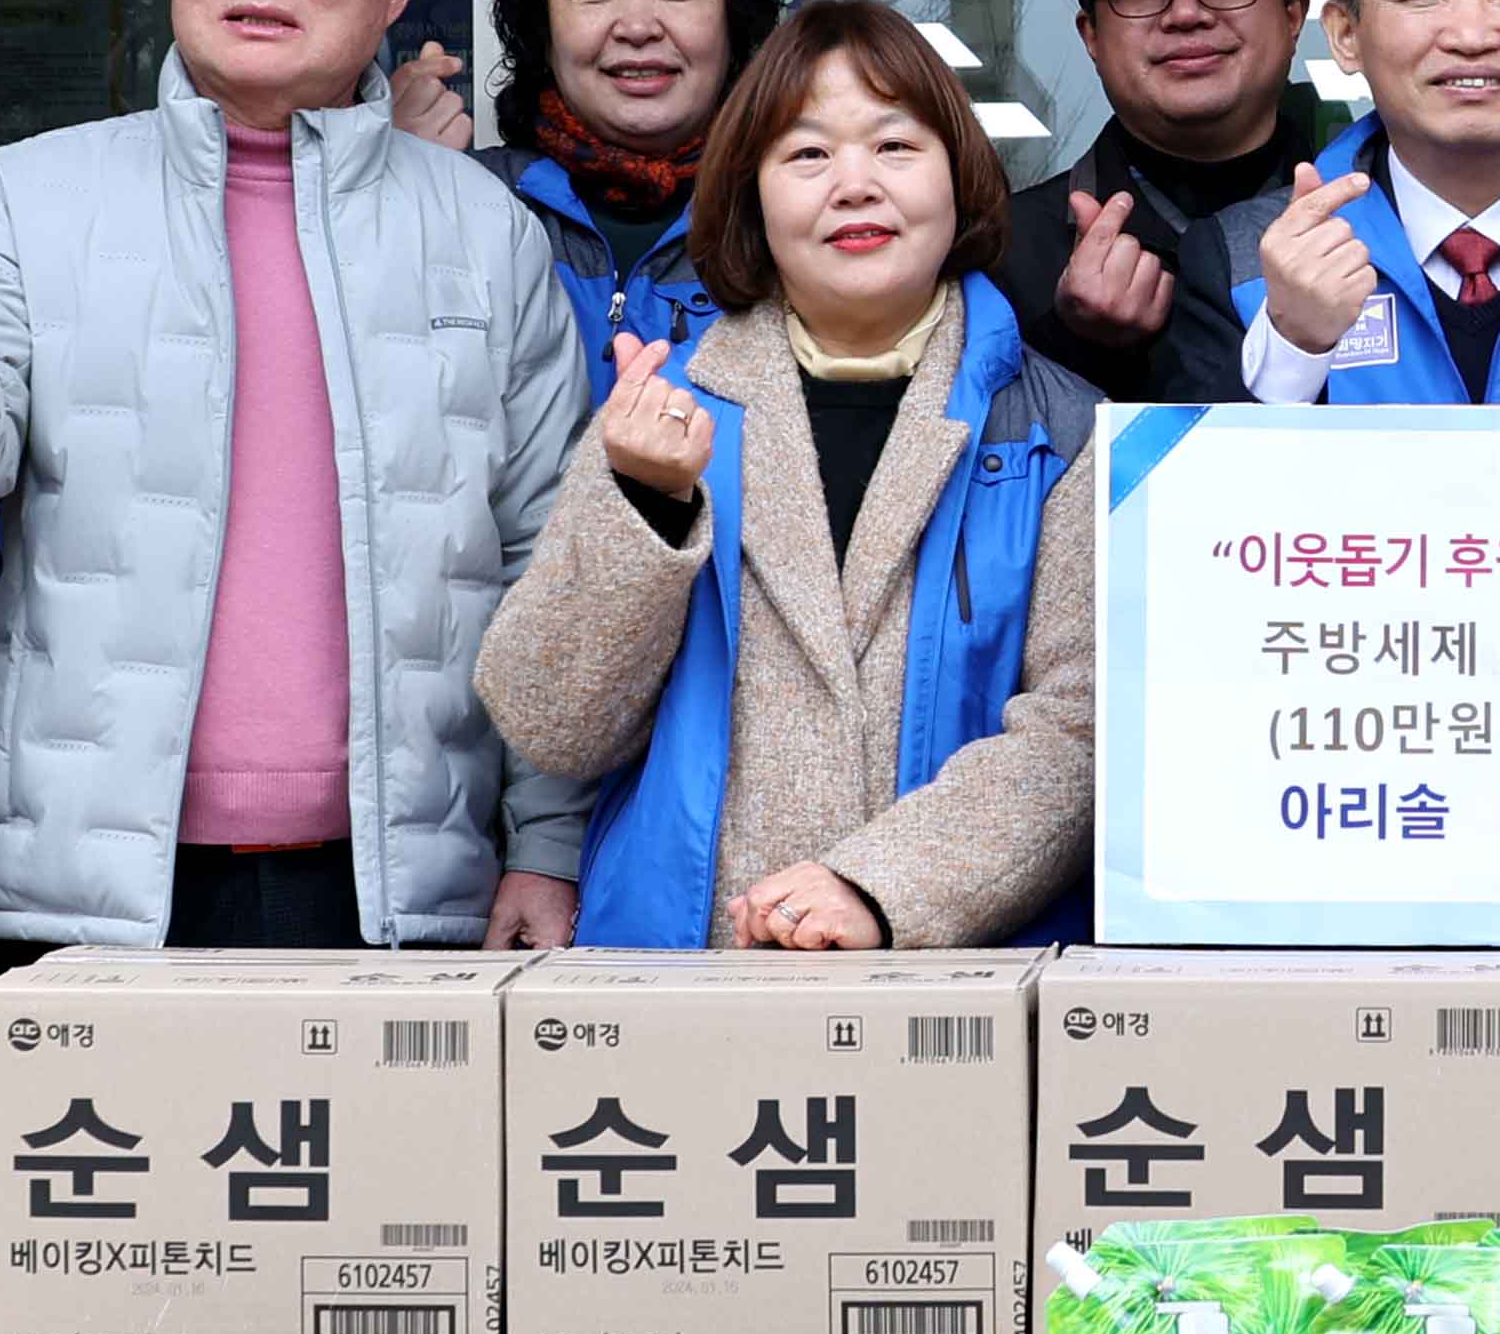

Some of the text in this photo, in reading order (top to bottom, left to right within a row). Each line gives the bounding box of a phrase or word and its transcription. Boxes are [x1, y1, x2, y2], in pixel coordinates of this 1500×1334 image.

[1262, 621, 1476, 676] 주방세제
[1270, 702, 1492, 760] (110만원
[1281, 783, 1450, 840] 아리솔
[46, 1024, 94, 1048] 애경
[573, 1023, 620, 1048] 애경
[13, 1098, 330, 1222] 순 샘
[541, 1095, 856, 1219] 순 샘
[1068, 1086, 1384, 1210] 순 샘
[10, 1239, 257, 1276] 베이킹X피톤치드
[335, 1260, 433, 1290] 6102457
[539, 1238, 785, 1275] 베이킹X피톤치드
[864, 1258, 961, 1288] 6102457
